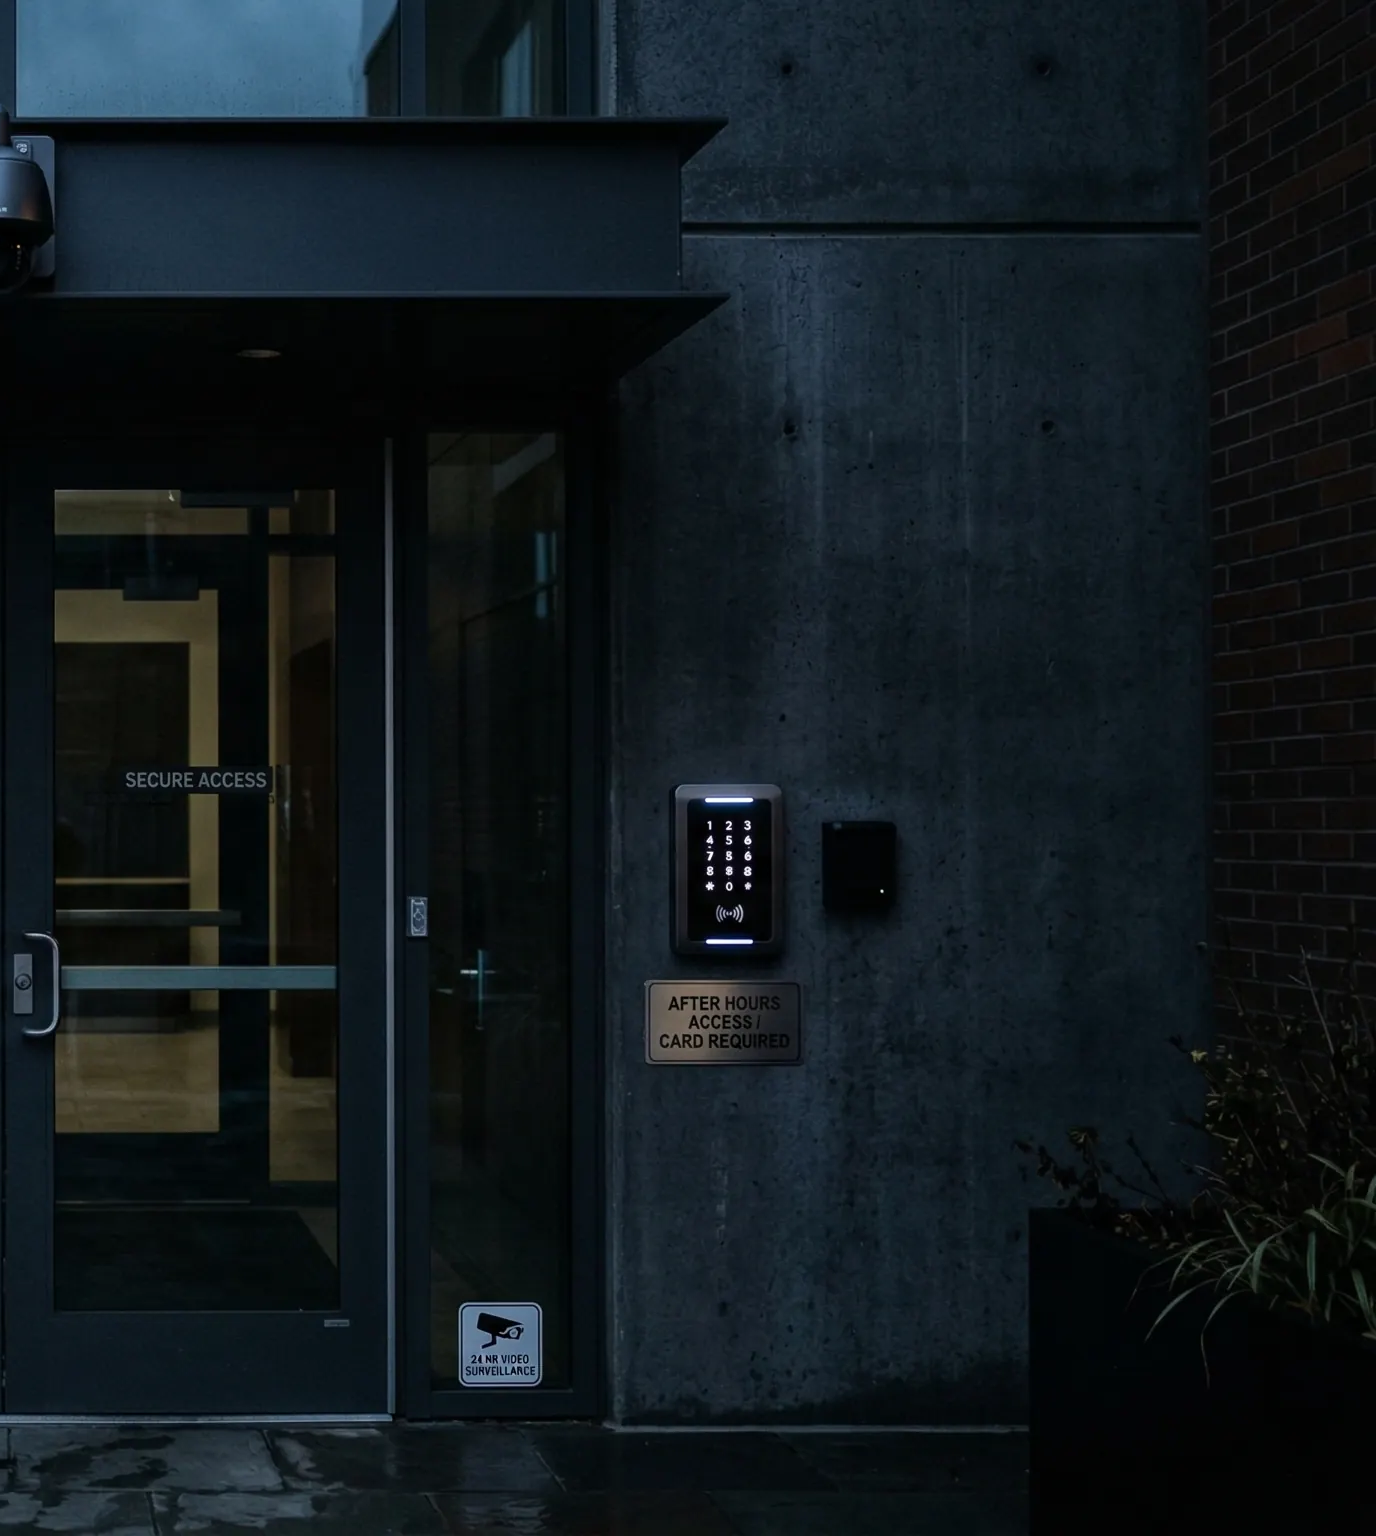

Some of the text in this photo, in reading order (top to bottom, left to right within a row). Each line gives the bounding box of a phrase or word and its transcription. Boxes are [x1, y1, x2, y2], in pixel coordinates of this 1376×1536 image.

[125, 772, 267, 788] SECURE ACCESS
[707, 820, 751, 830] 1 2 3
[706, 835, 752, 845] 4 5 6
[706, 851, 752, 861] 7 8 6
[726, 882, 733, 891] 0
[668, 996, 781, 1010] AFTER HOURS
[689, 1015, 752, 1029] ACCESS
[660, 1034, 790, 1048] CARD REQUIRED
[471, 1354, 482, 1364] 24
[501, 1354, 529, 1364] VIDEO
